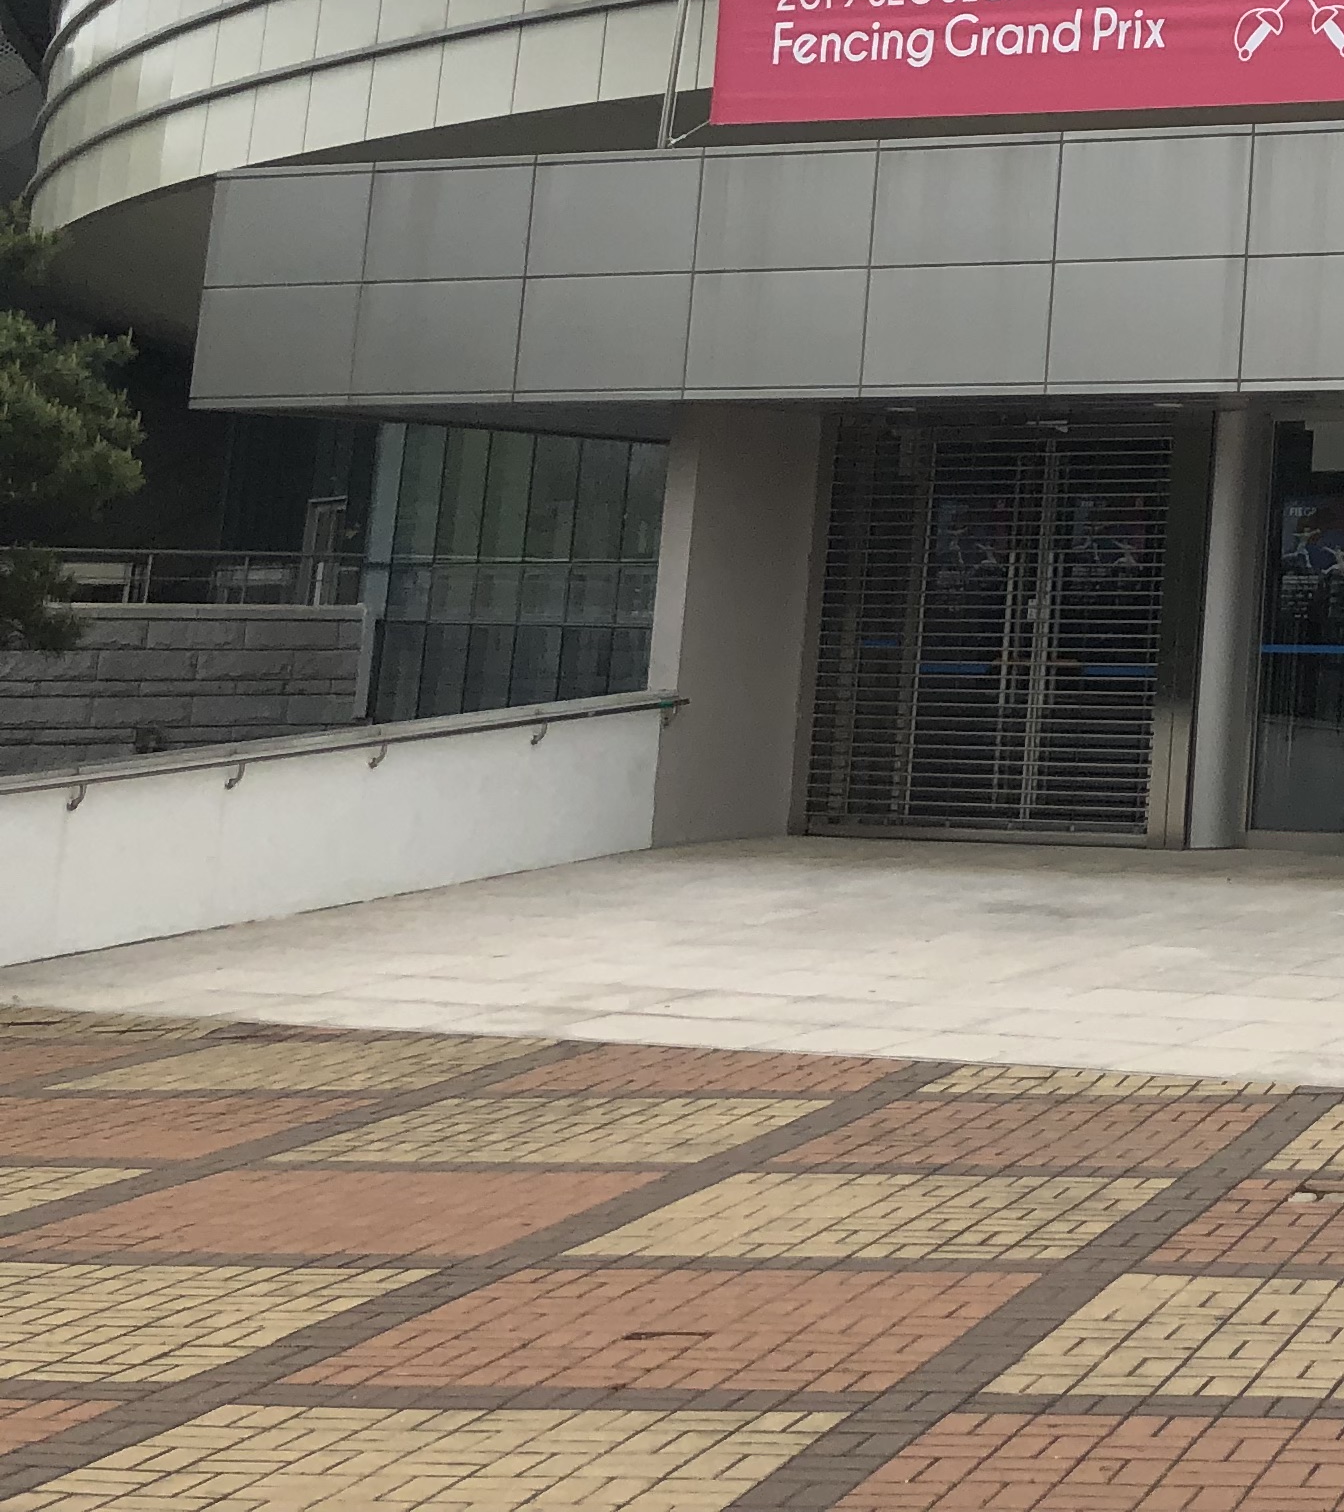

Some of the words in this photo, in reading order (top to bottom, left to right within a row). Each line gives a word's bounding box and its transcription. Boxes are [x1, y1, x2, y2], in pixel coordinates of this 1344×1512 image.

[772, 18, 935, 68] Fencing
[944, 9, 1085, 58] Grand
[1092, 6, 1166, 52] Prix
